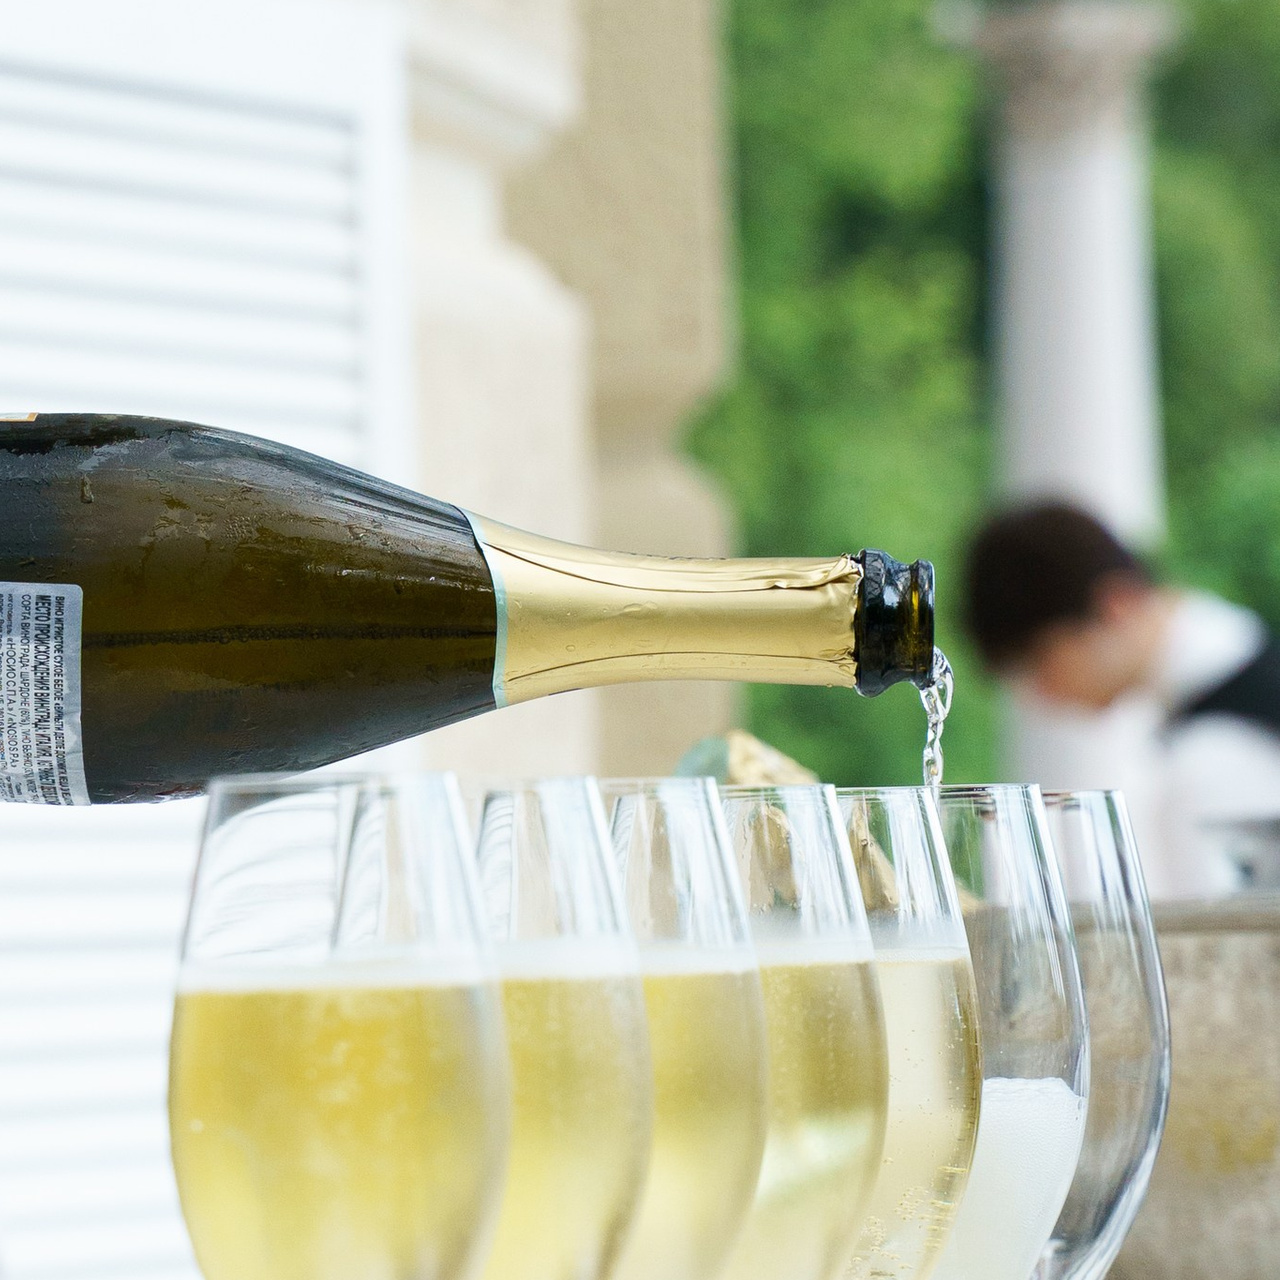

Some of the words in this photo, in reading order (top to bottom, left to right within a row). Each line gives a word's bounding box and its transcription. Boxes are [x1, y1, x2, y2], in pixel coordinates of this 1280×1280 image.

[21, 594, 31, 620] СОРТА
[35, 595, 51, 622] МЕСТО
[55, 596, 65, 616] ВИНО
[54, 617, 64, 654] ИГРИСТОЕ
[31, 623, 51, 691] ПРОИСХОЖДЕНИЯ
[54, 655, 64, 677] СУХОЕ
[19, 671, 30, 706] ШАРДОНЕ
[54, 679, 64, 701] БЕЛОЕ
